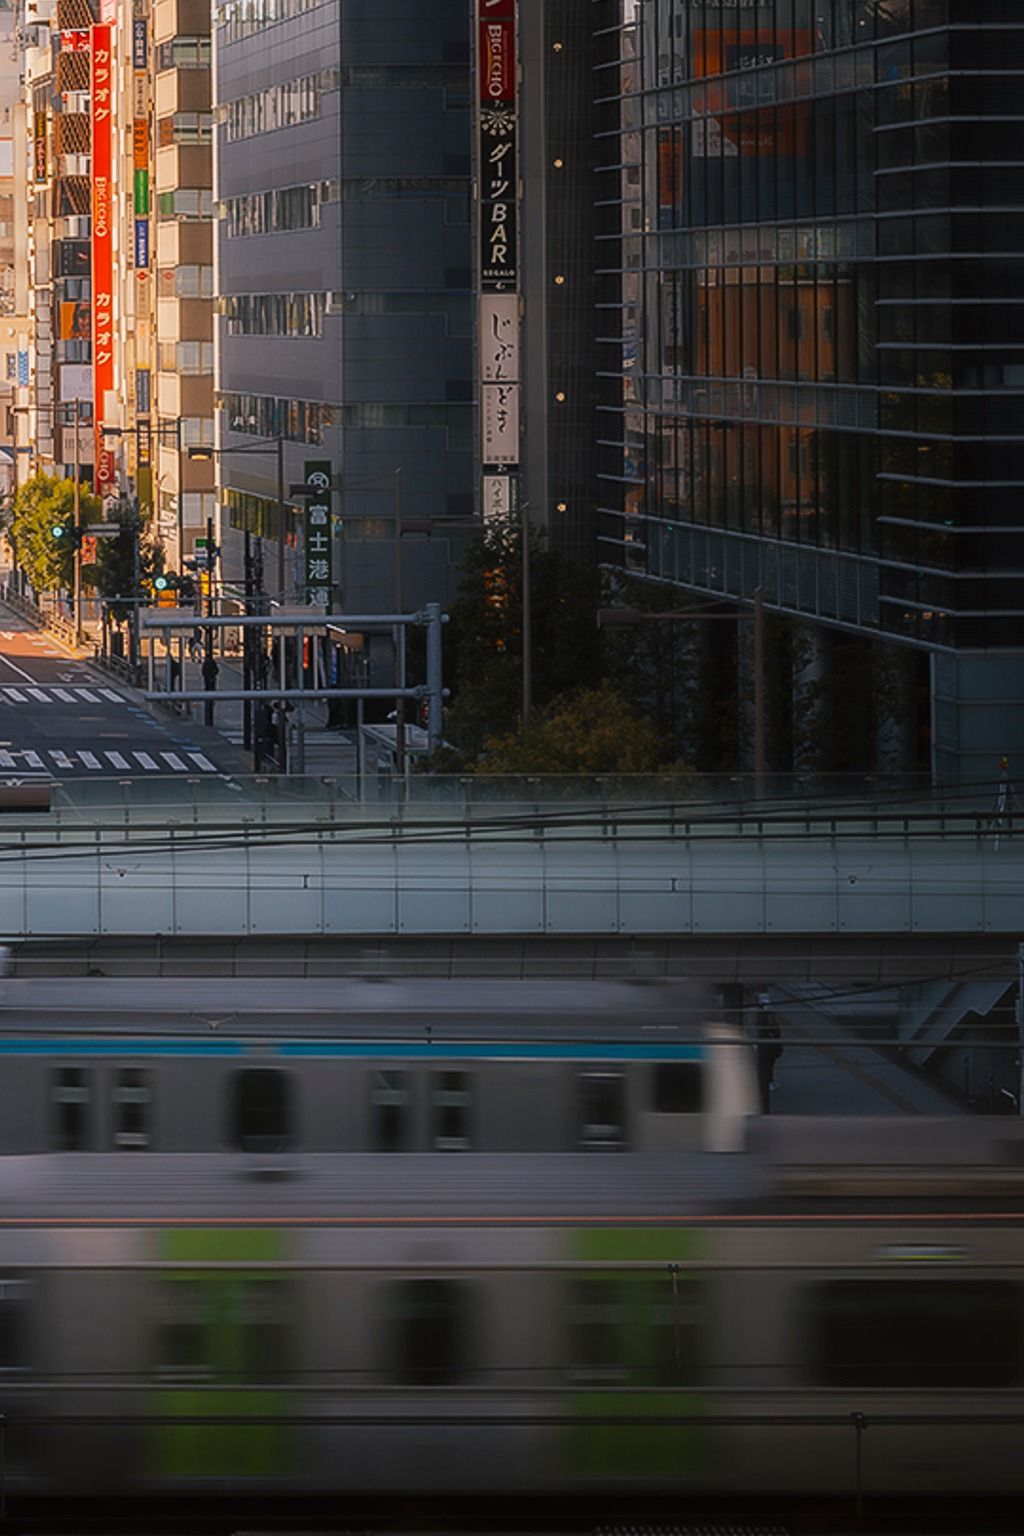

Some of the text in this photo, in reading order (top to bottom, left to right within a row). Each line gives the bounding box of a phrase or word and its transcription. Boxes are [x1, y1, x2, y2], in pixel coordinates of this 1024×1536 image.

[94, 49, 110, 122] カラオケ
[488, 24, 504, 97] BIG ECHO
[95, 292, 112, 365] カラオケ
